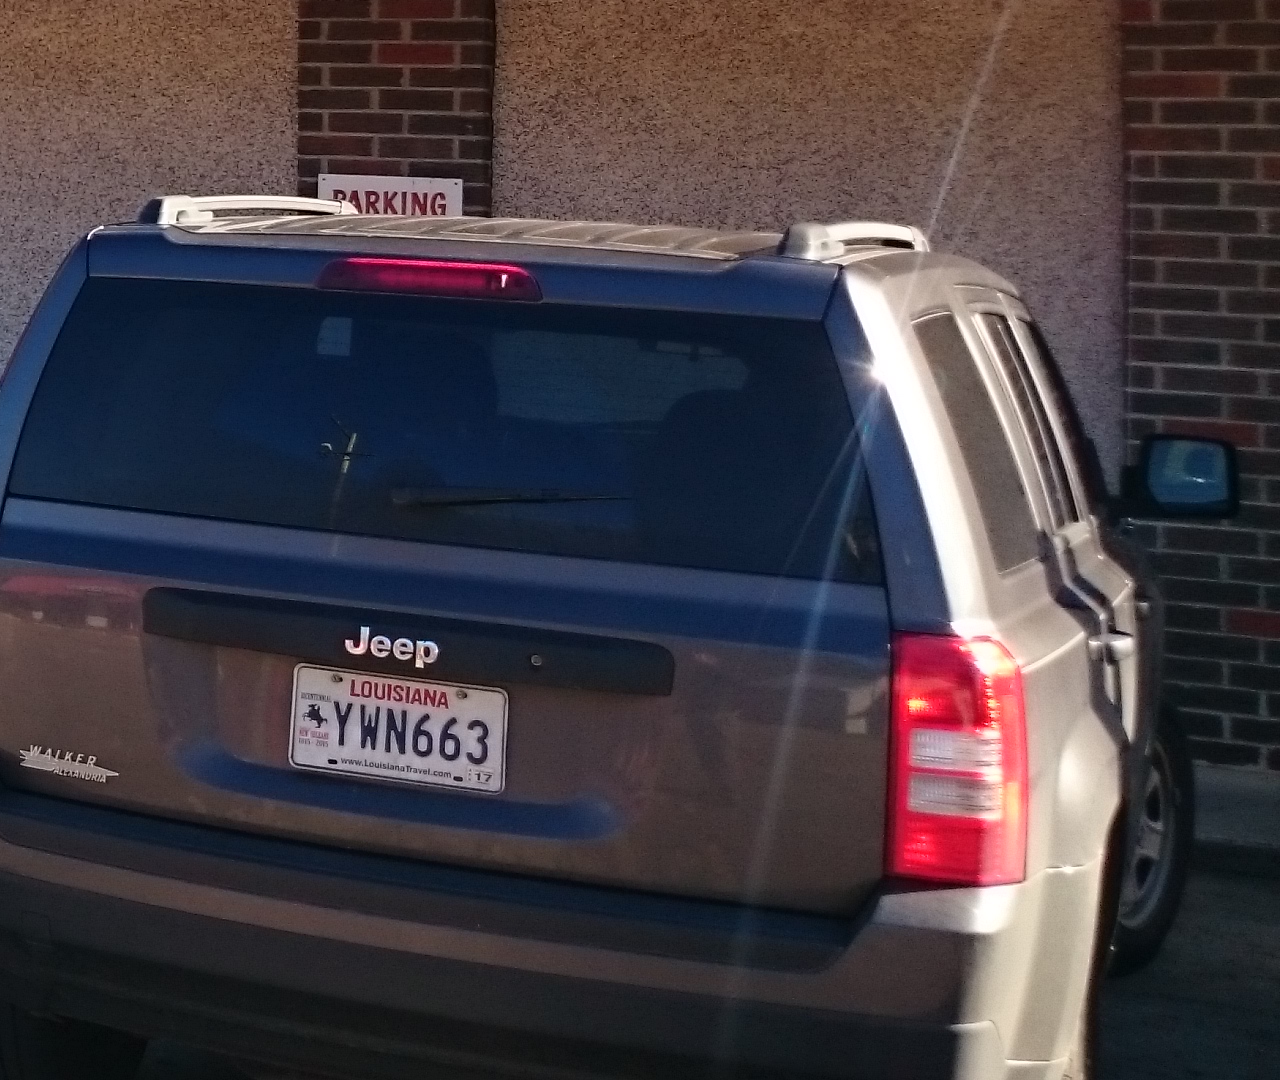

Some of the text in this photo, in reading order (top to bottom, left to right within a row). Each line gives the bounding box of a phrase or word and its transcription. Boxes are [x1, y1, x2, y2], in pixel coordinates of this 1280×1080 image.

[344, 625, 439, 669] Jeep
[349, 678, 449, 710] LOUISIANA
[333, 700, 490, 766] YWN663
[29, 744, 98, 768] WALKER
[53, 766, 107, 783] ALEXANDRIA
[340, 757, 452, 780] www.LouisianaTravel.com
[474, 772, 493, 783] 17
